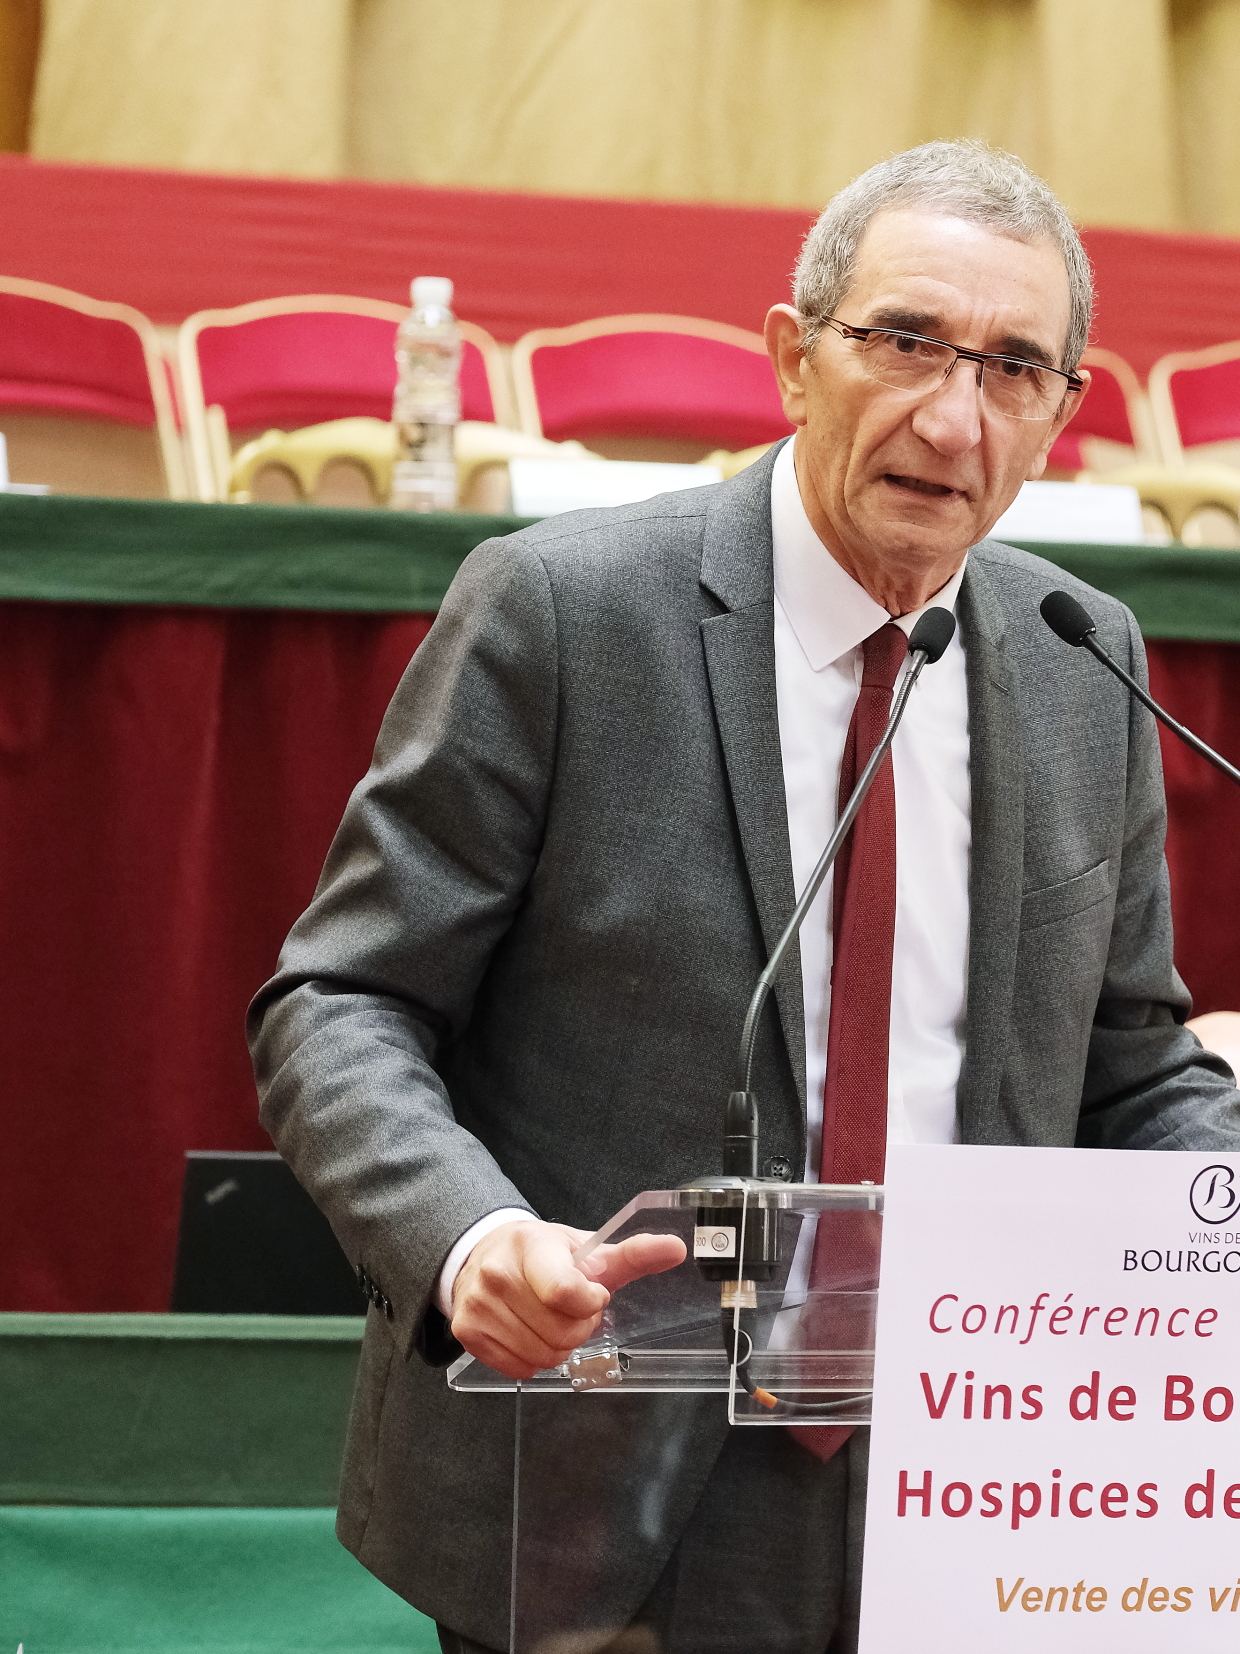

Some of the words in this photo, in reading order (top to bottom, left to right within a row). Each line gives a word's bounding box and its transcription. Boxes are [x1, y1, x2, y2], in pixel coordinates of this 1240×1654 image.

[1188, 1231, 1221, 1244] VINS
[928, 1292, 1219, 1345] Conférence
[919, 1370, 1044, 1421] Vins
[1068, 1370, 1137, 1422] de
[896, 1468, 1159, 1531] Hospices
[995, 1577, 1108, 1613] Vente
[1121, 1577, 1194, 1613] des
